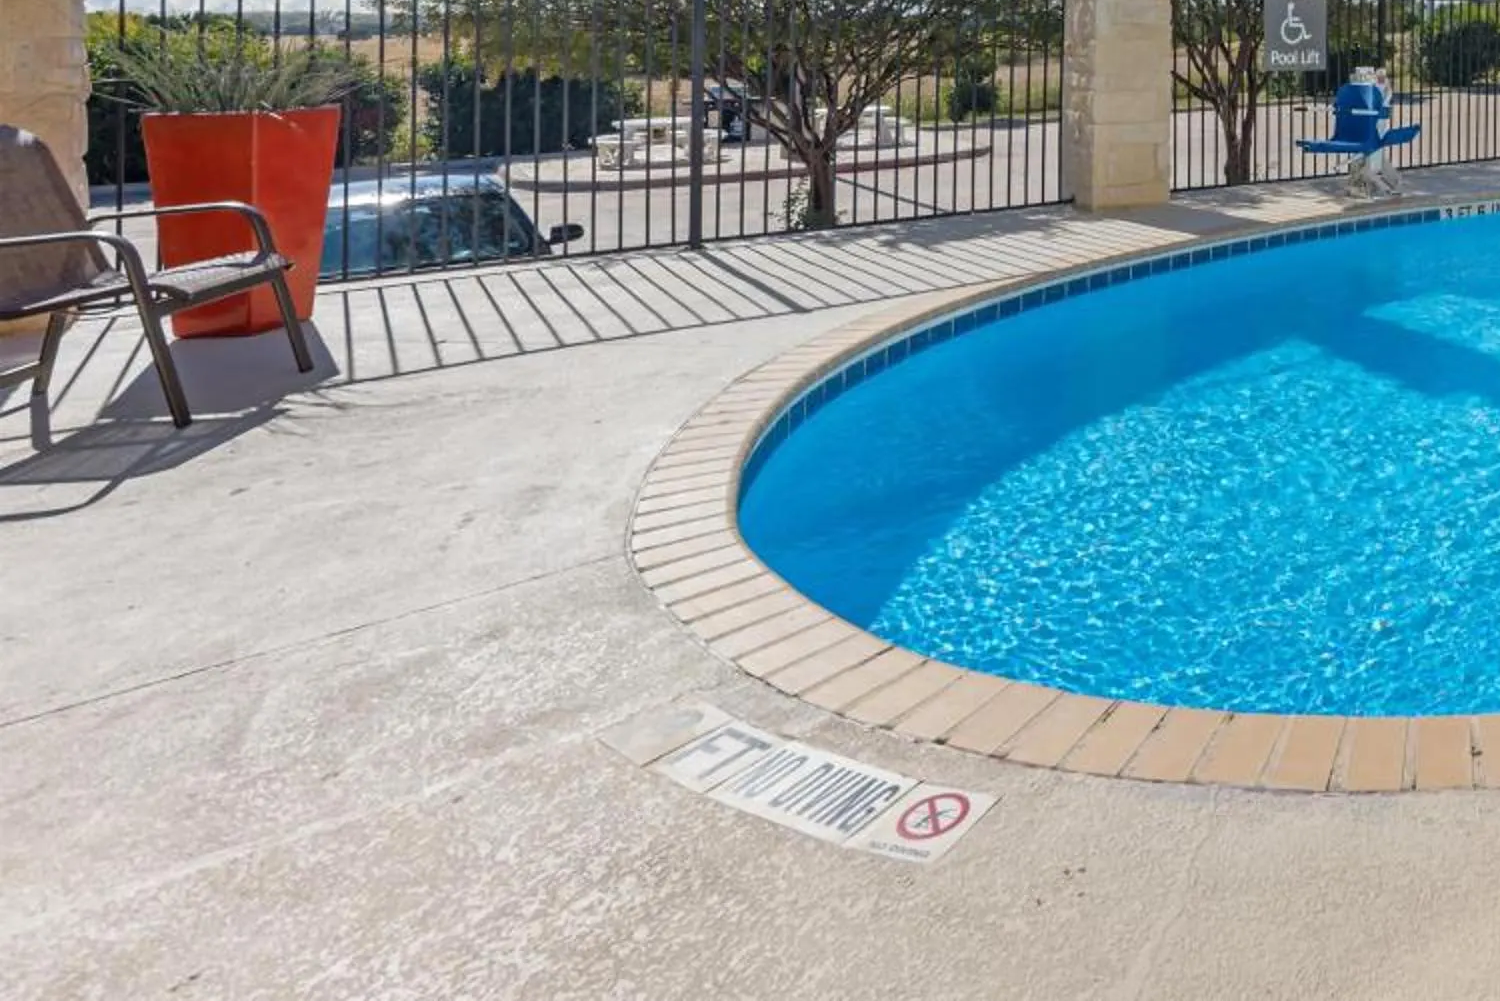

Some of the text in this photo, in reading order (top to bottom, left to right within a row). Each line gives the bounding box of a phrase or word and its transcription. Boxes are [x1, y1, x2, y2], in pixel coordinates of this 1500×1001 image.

[1271, 48, 1320, 66] Pool Lift
[668, 727, 901, 833] FT NO DIVING
